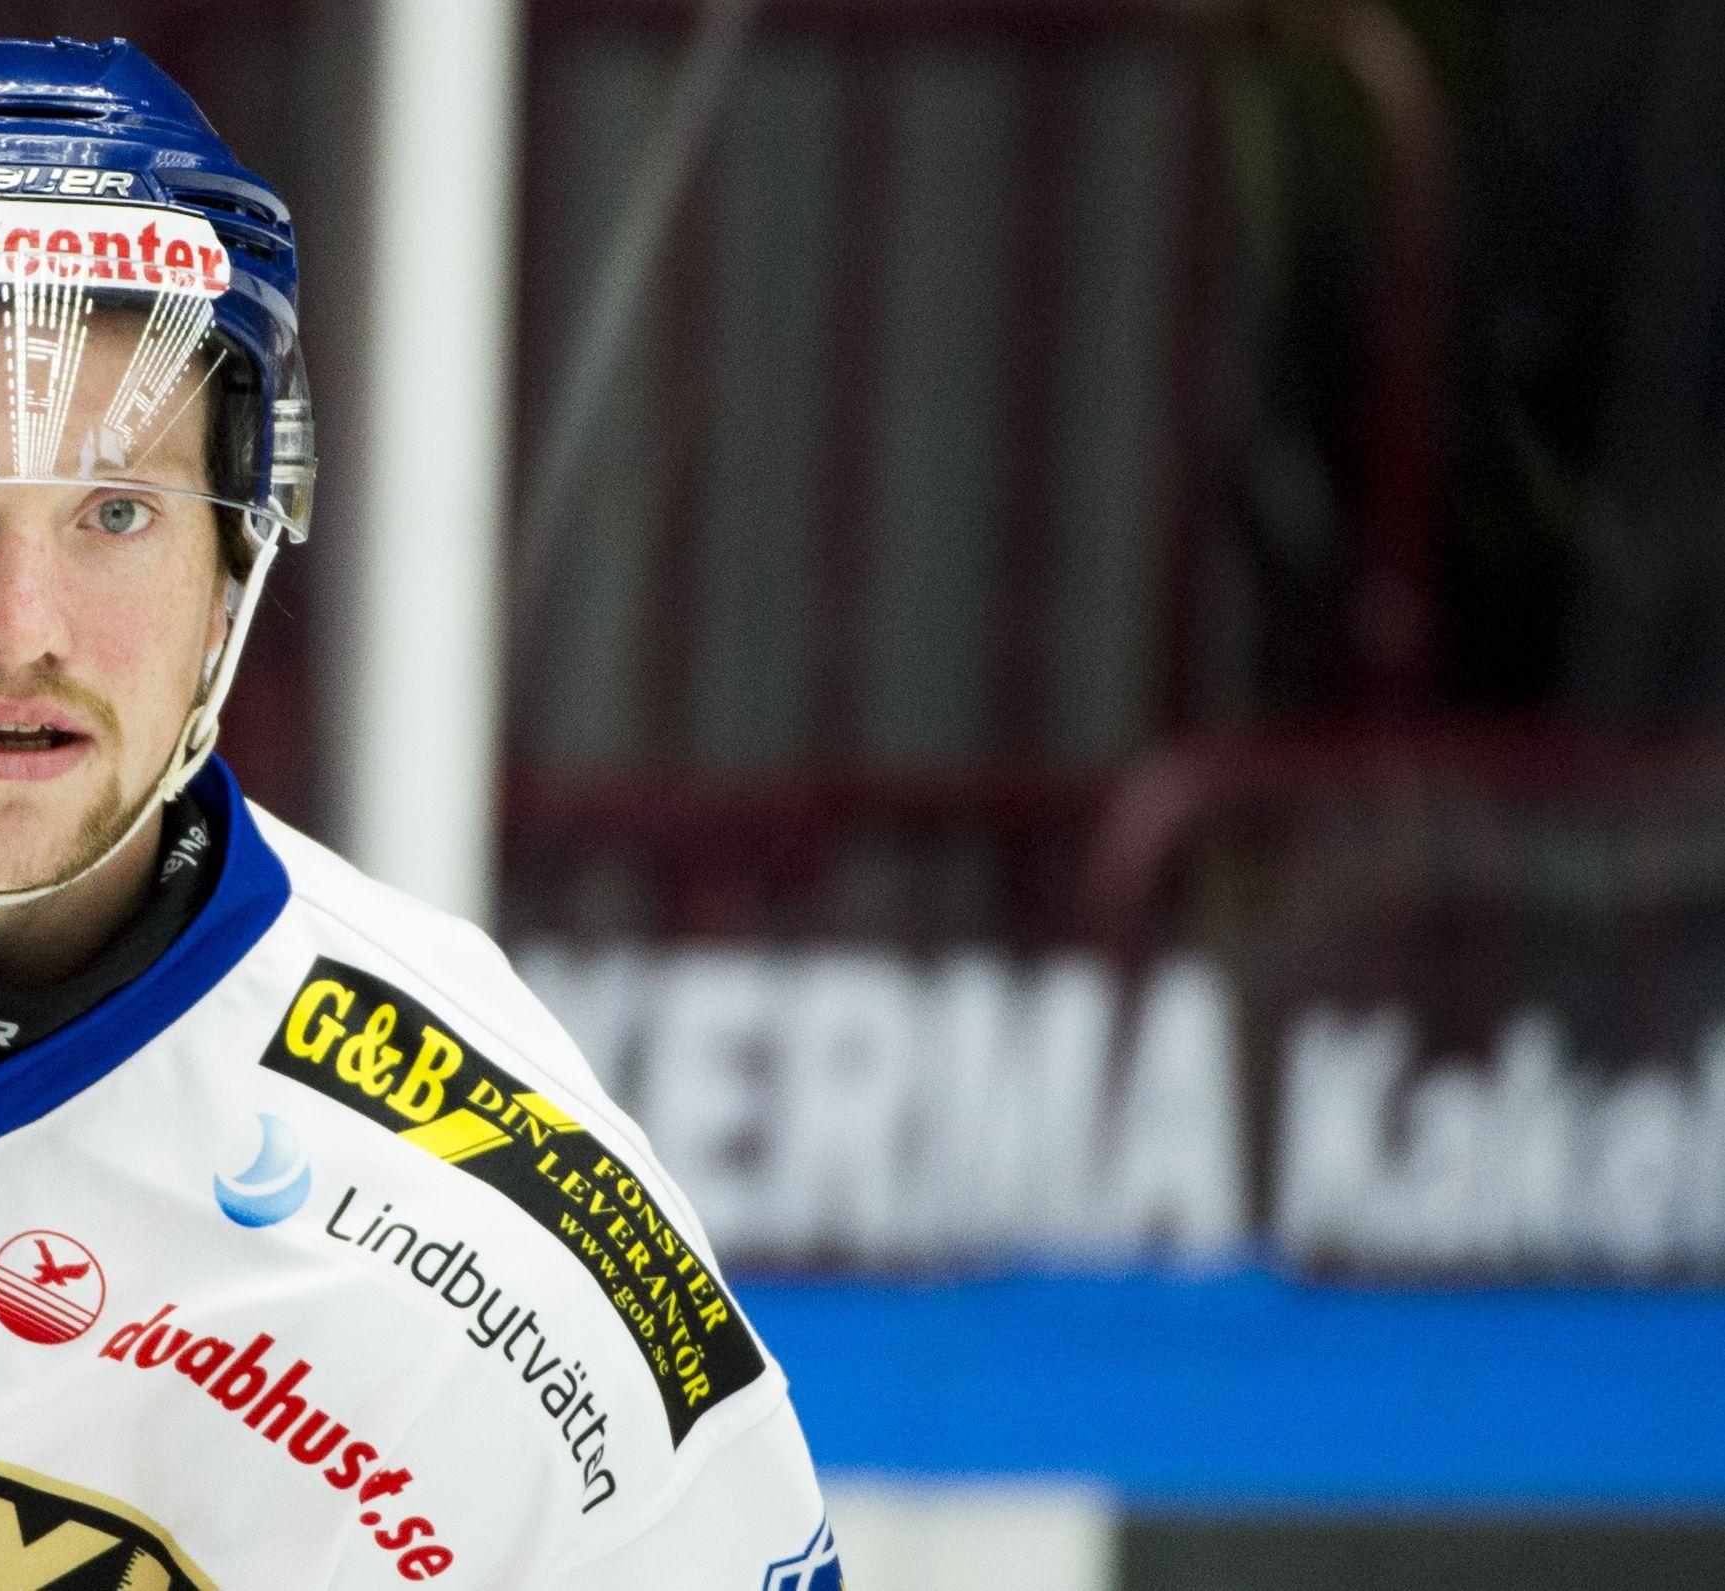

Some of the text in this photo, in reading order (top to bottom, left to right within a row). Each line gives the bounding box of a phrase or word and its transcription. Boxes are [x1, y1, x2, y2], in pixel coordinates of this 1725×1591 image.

[284, 978, 464, 1125] G&B
[466, 1078, 553, 1148] DIN
[535, 1150, 710, 1406] LEVERANTÖR
[559, 1212, 670, 1377] www.gob.se
[593, 1155, 728, 1332] FÖNSTER
[97, 1302, 455, 1582] duabhust.se
